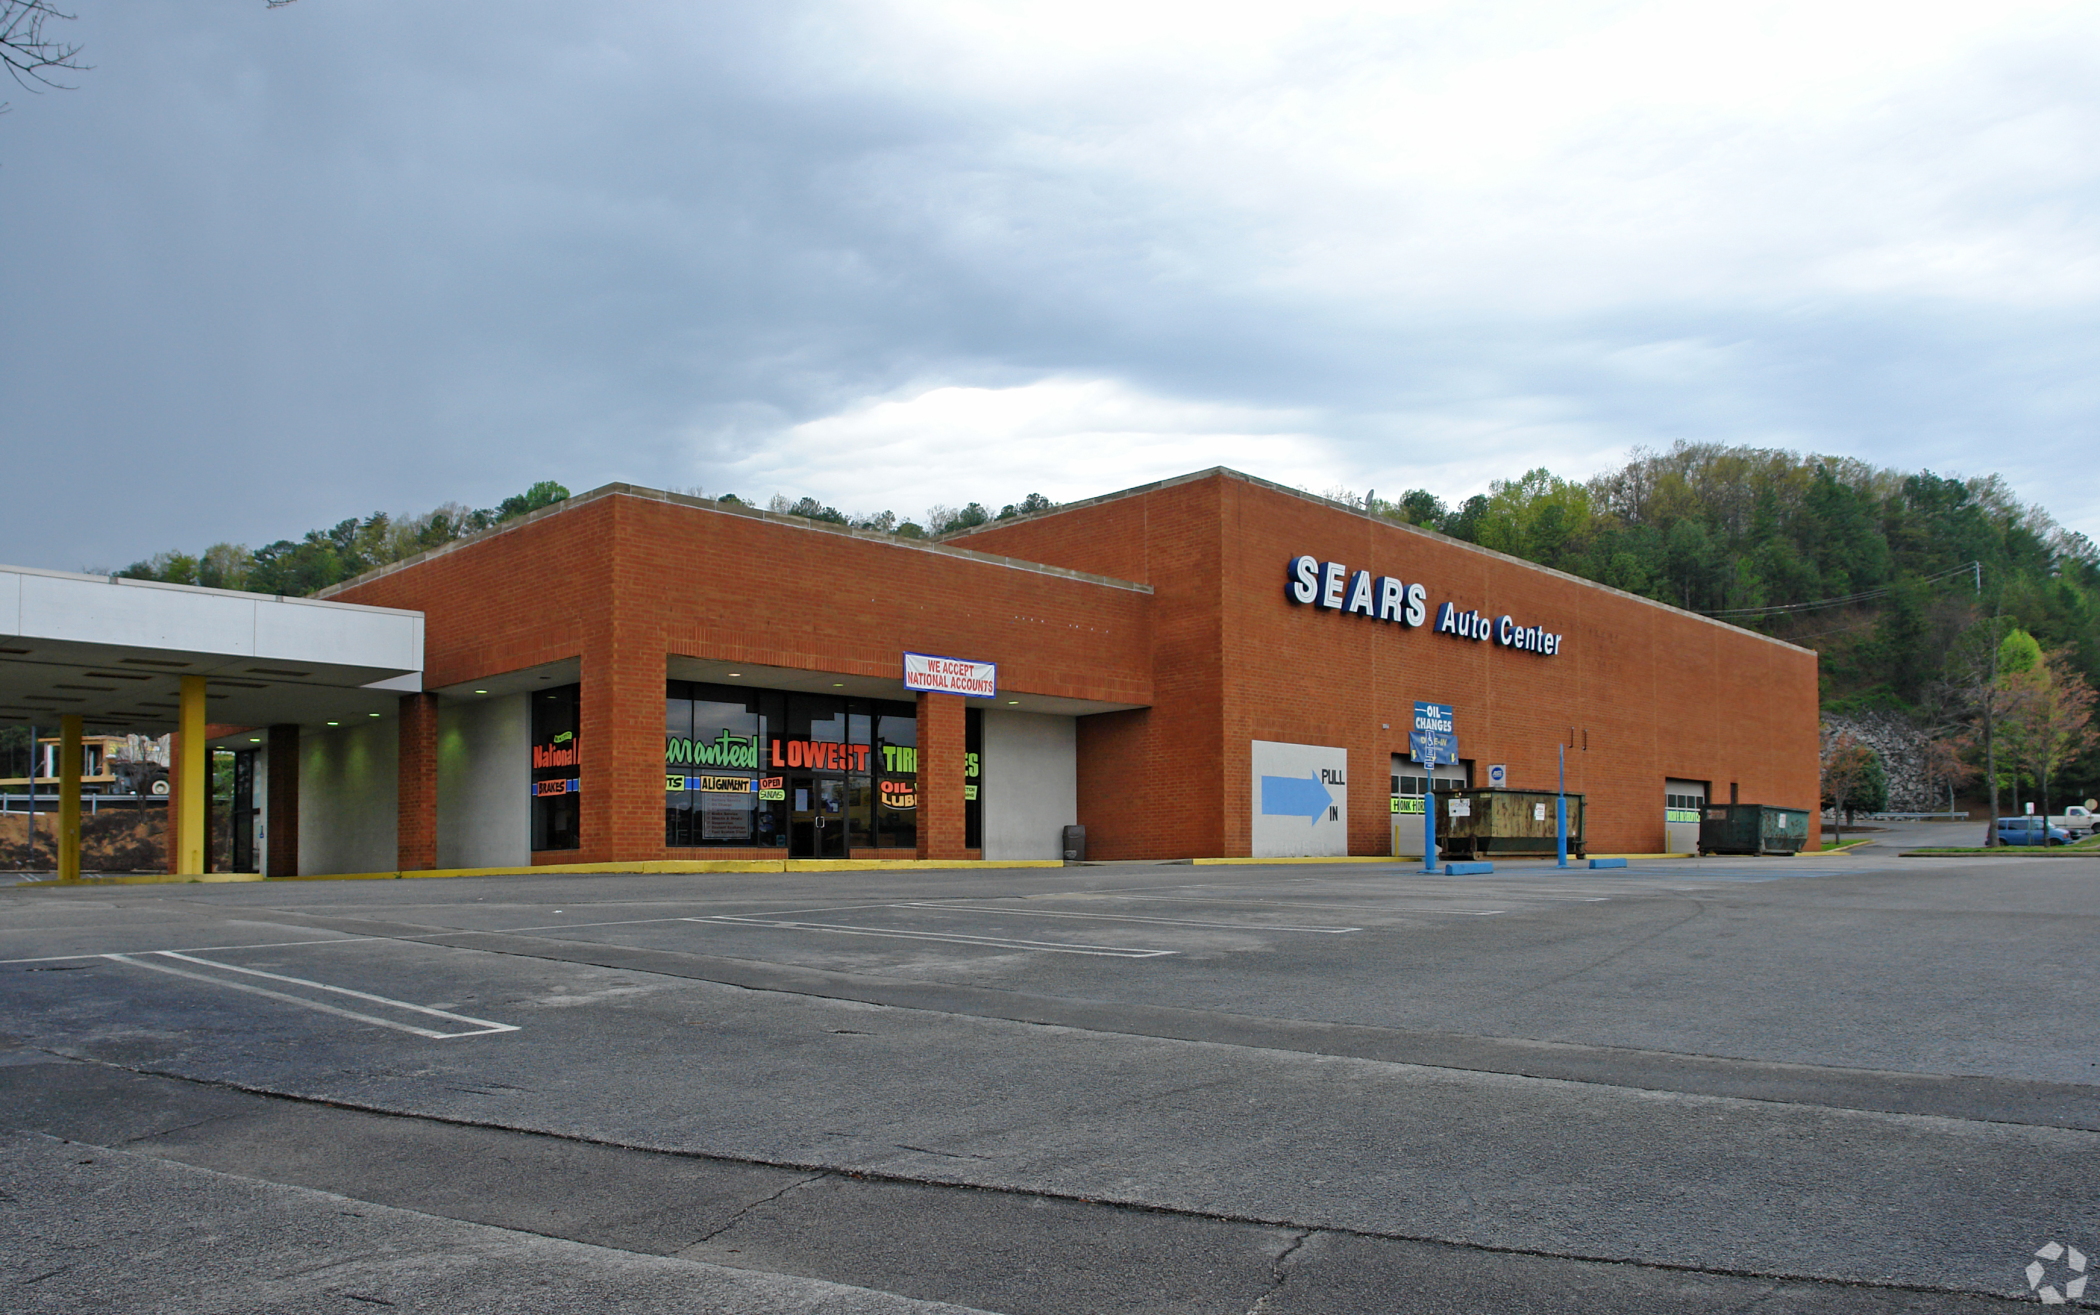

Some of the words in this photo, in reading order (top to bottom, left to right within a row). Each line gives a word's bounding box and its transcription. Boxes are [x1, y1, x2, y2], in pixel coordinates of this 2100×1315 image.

[1287, 556, 1426, 627] SEARS
[1437, 602, 1490, 641] Auto
[1495, 615, 1562, 655] Center
[928, 660, 940, 673] WE
[943, 662, 974, 677] ACCEPT
[907, 671, 948, 688] NATIONAL
[950, 676, 993, 693] ACCOUNTS
[1427, 705, 1441, 718] OIL
[1415, 717, 1452, 732] CHANGES
[533, 737, 577, 769] National
[666, 728, 758, 769] aranteed
[772, 739, 870, 772] LOWEST
[762, 779, 780, 788] OPEN
[1322, 769, 1345, 785] PULL
[538, 781, 565, 794] BRAKES
[880, 781, 913, 793] OIL
[882, 792, 917, 807] LUB
[1329, 806, 1338, 821] IN
